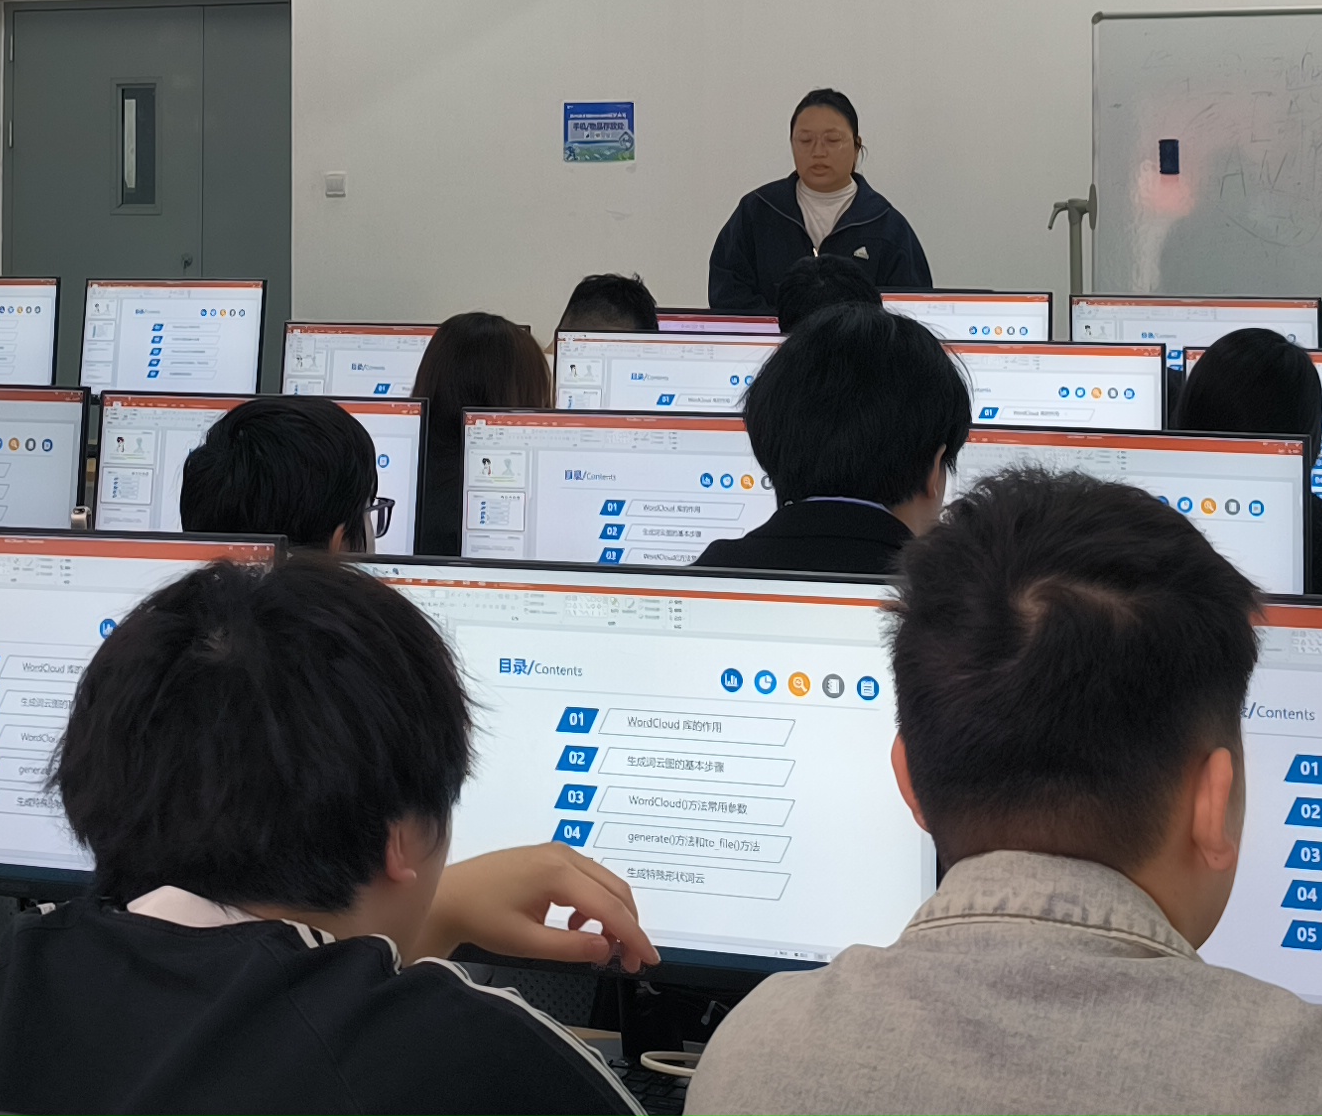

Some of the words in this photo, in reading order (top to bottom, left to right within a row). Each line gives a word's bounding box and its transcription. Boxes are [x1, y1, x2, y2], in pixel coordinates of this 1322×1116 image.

[607, 503, 618, 512] 01
[606, 526, 618, 536] 02
[499, 657, 584, 677] 目录/Contents
[568, 711, 585, 727] 01
[627, 716, 680, 731] WordCloud
[568, 750, 586, 766] 02
[18, 765, 51, 776] genera
[1300, 761, 1319, 776] 01
[567, 790, 585, 805] 03
[1300, 803, 1322, 820] 02
[563, 825, 581, 840] 04
[1300, 846, 1322, 863] 03
[1296, 886, 1318, 903] 04
[1296, 926, 1318, 943] 05
